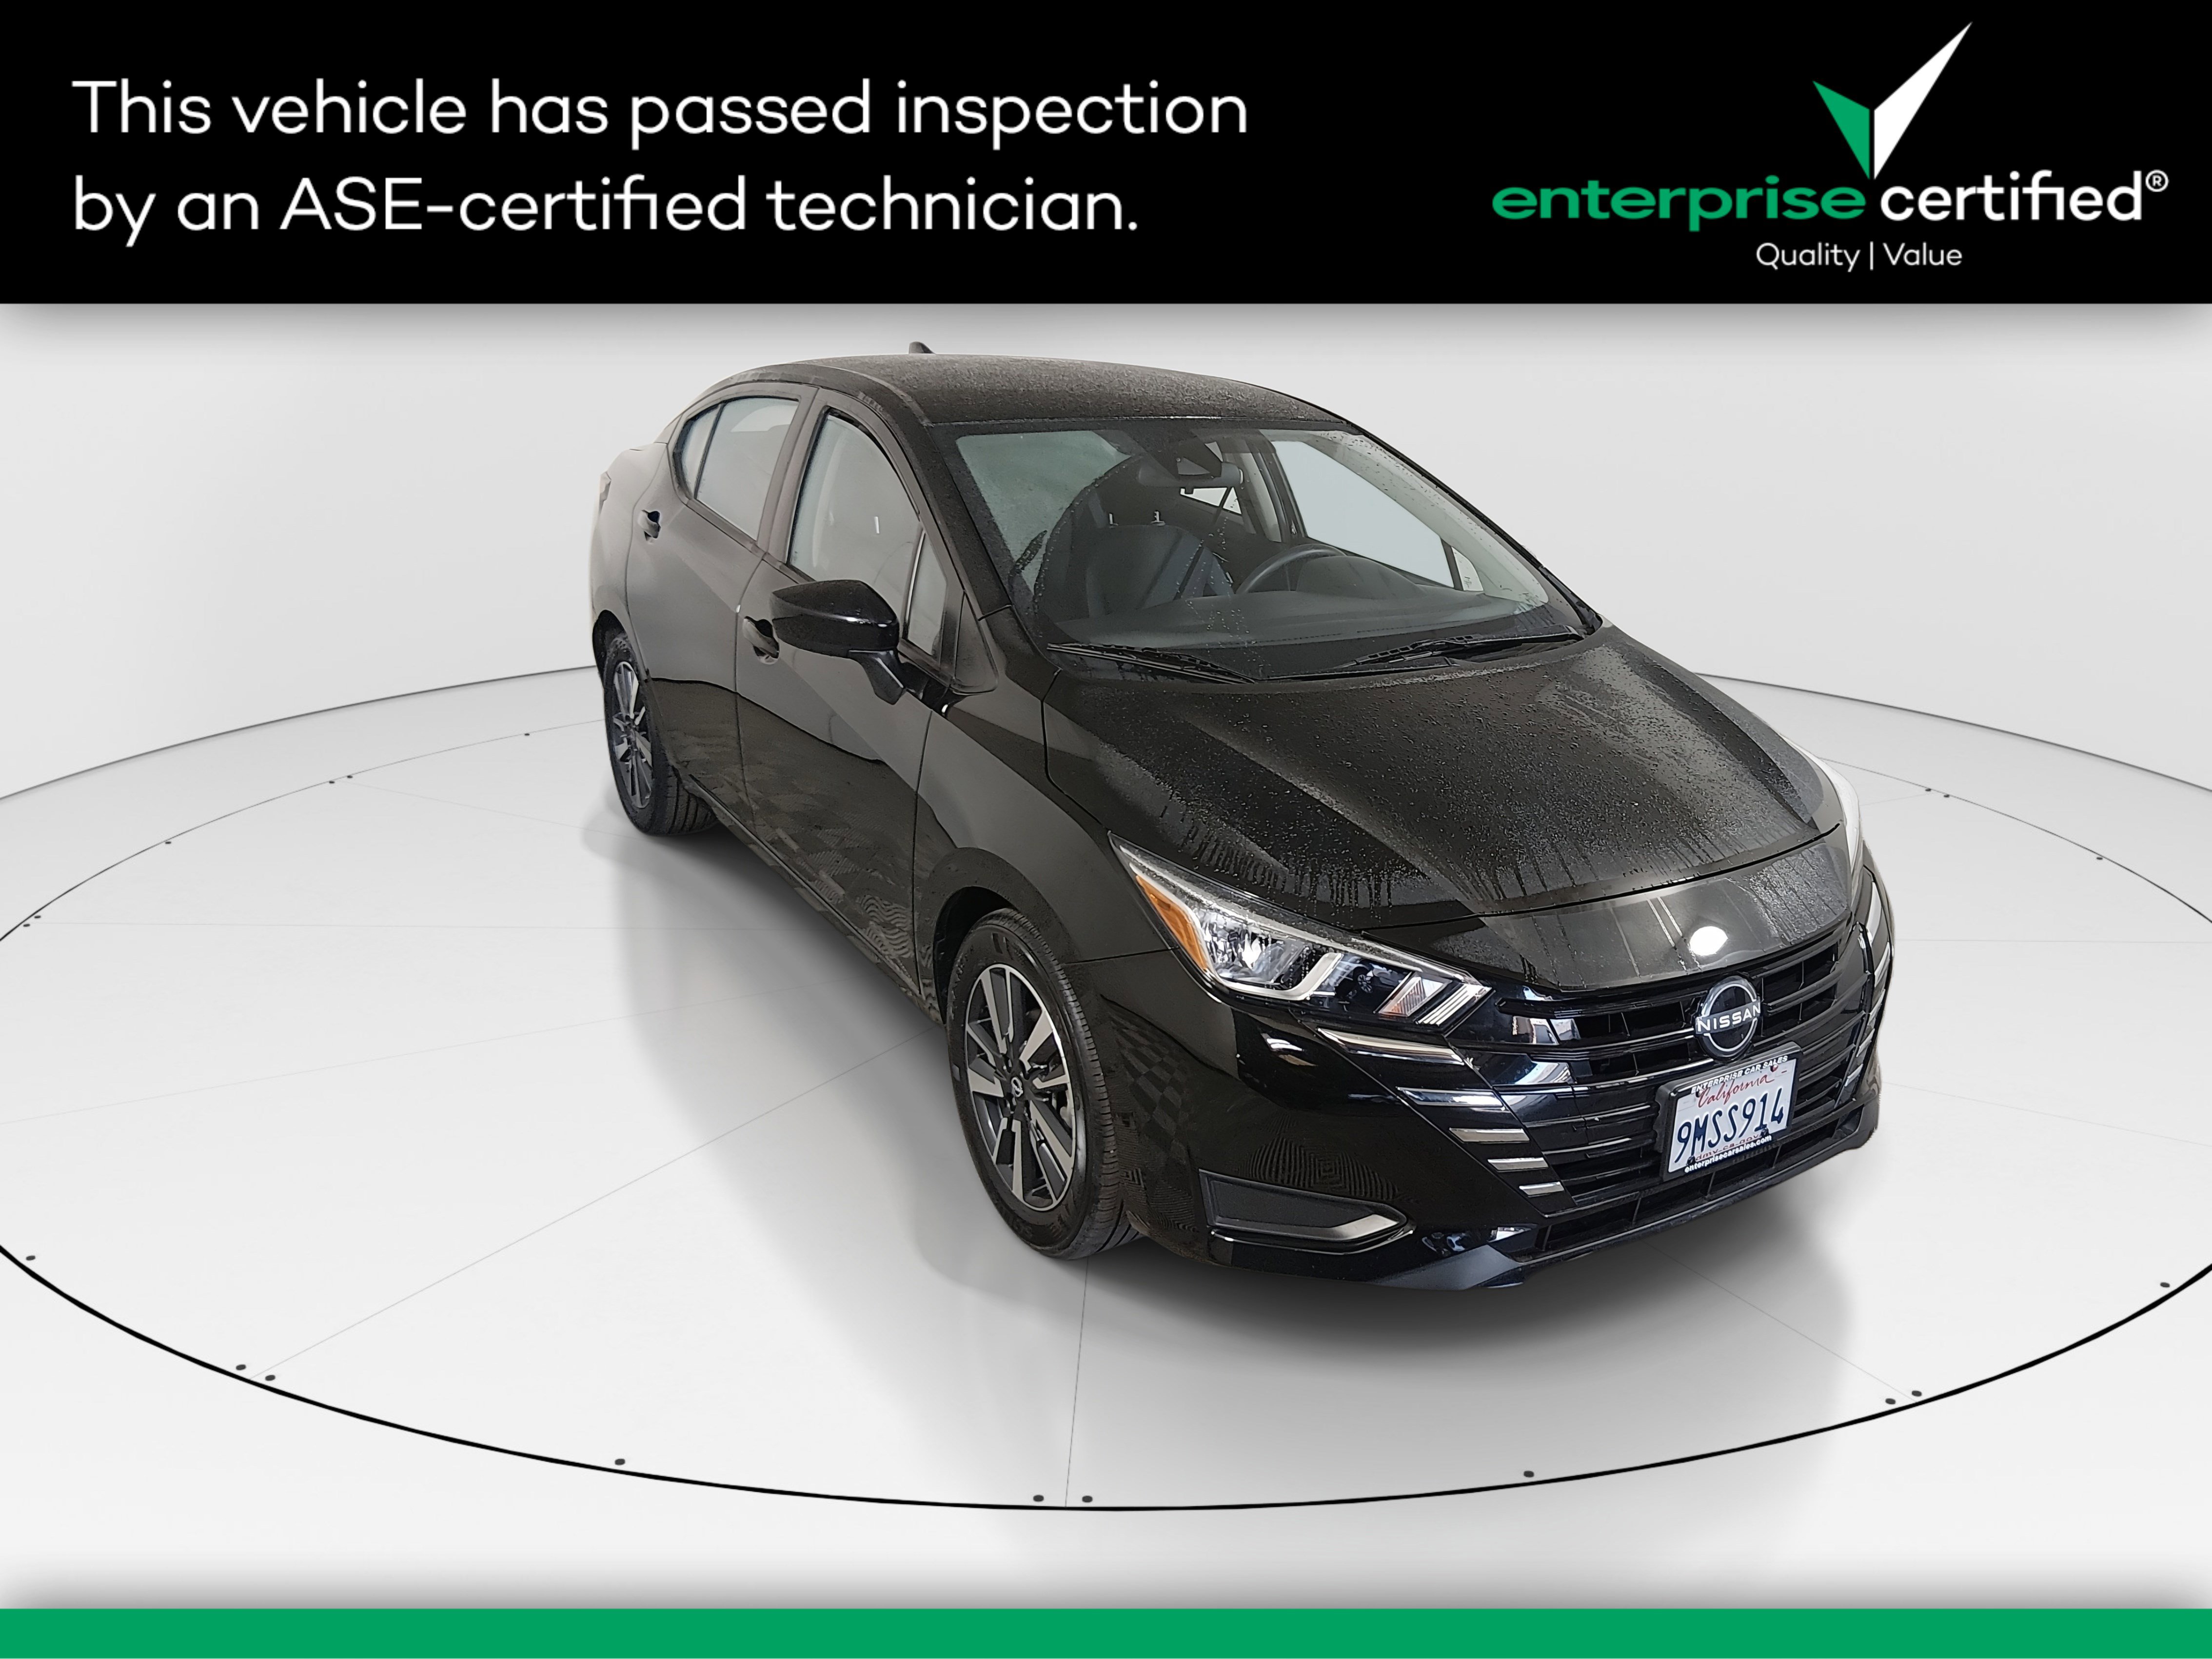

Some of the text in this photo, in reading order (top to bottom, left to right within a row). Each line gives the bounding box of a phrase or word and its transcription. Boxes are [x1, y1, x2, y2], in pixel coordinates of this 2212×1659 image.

[1696, 1002, 1761, 1032] NISSAN
[1691, 1055, 1788, 1094] ENTERPRISE CAR SALES
[1698, 1074, 1775, 1108] California
[1674, 1087, 1784, 1164] 9MSS914
[1684, 1135, 1772, 1173] enterprisecarsales.com
